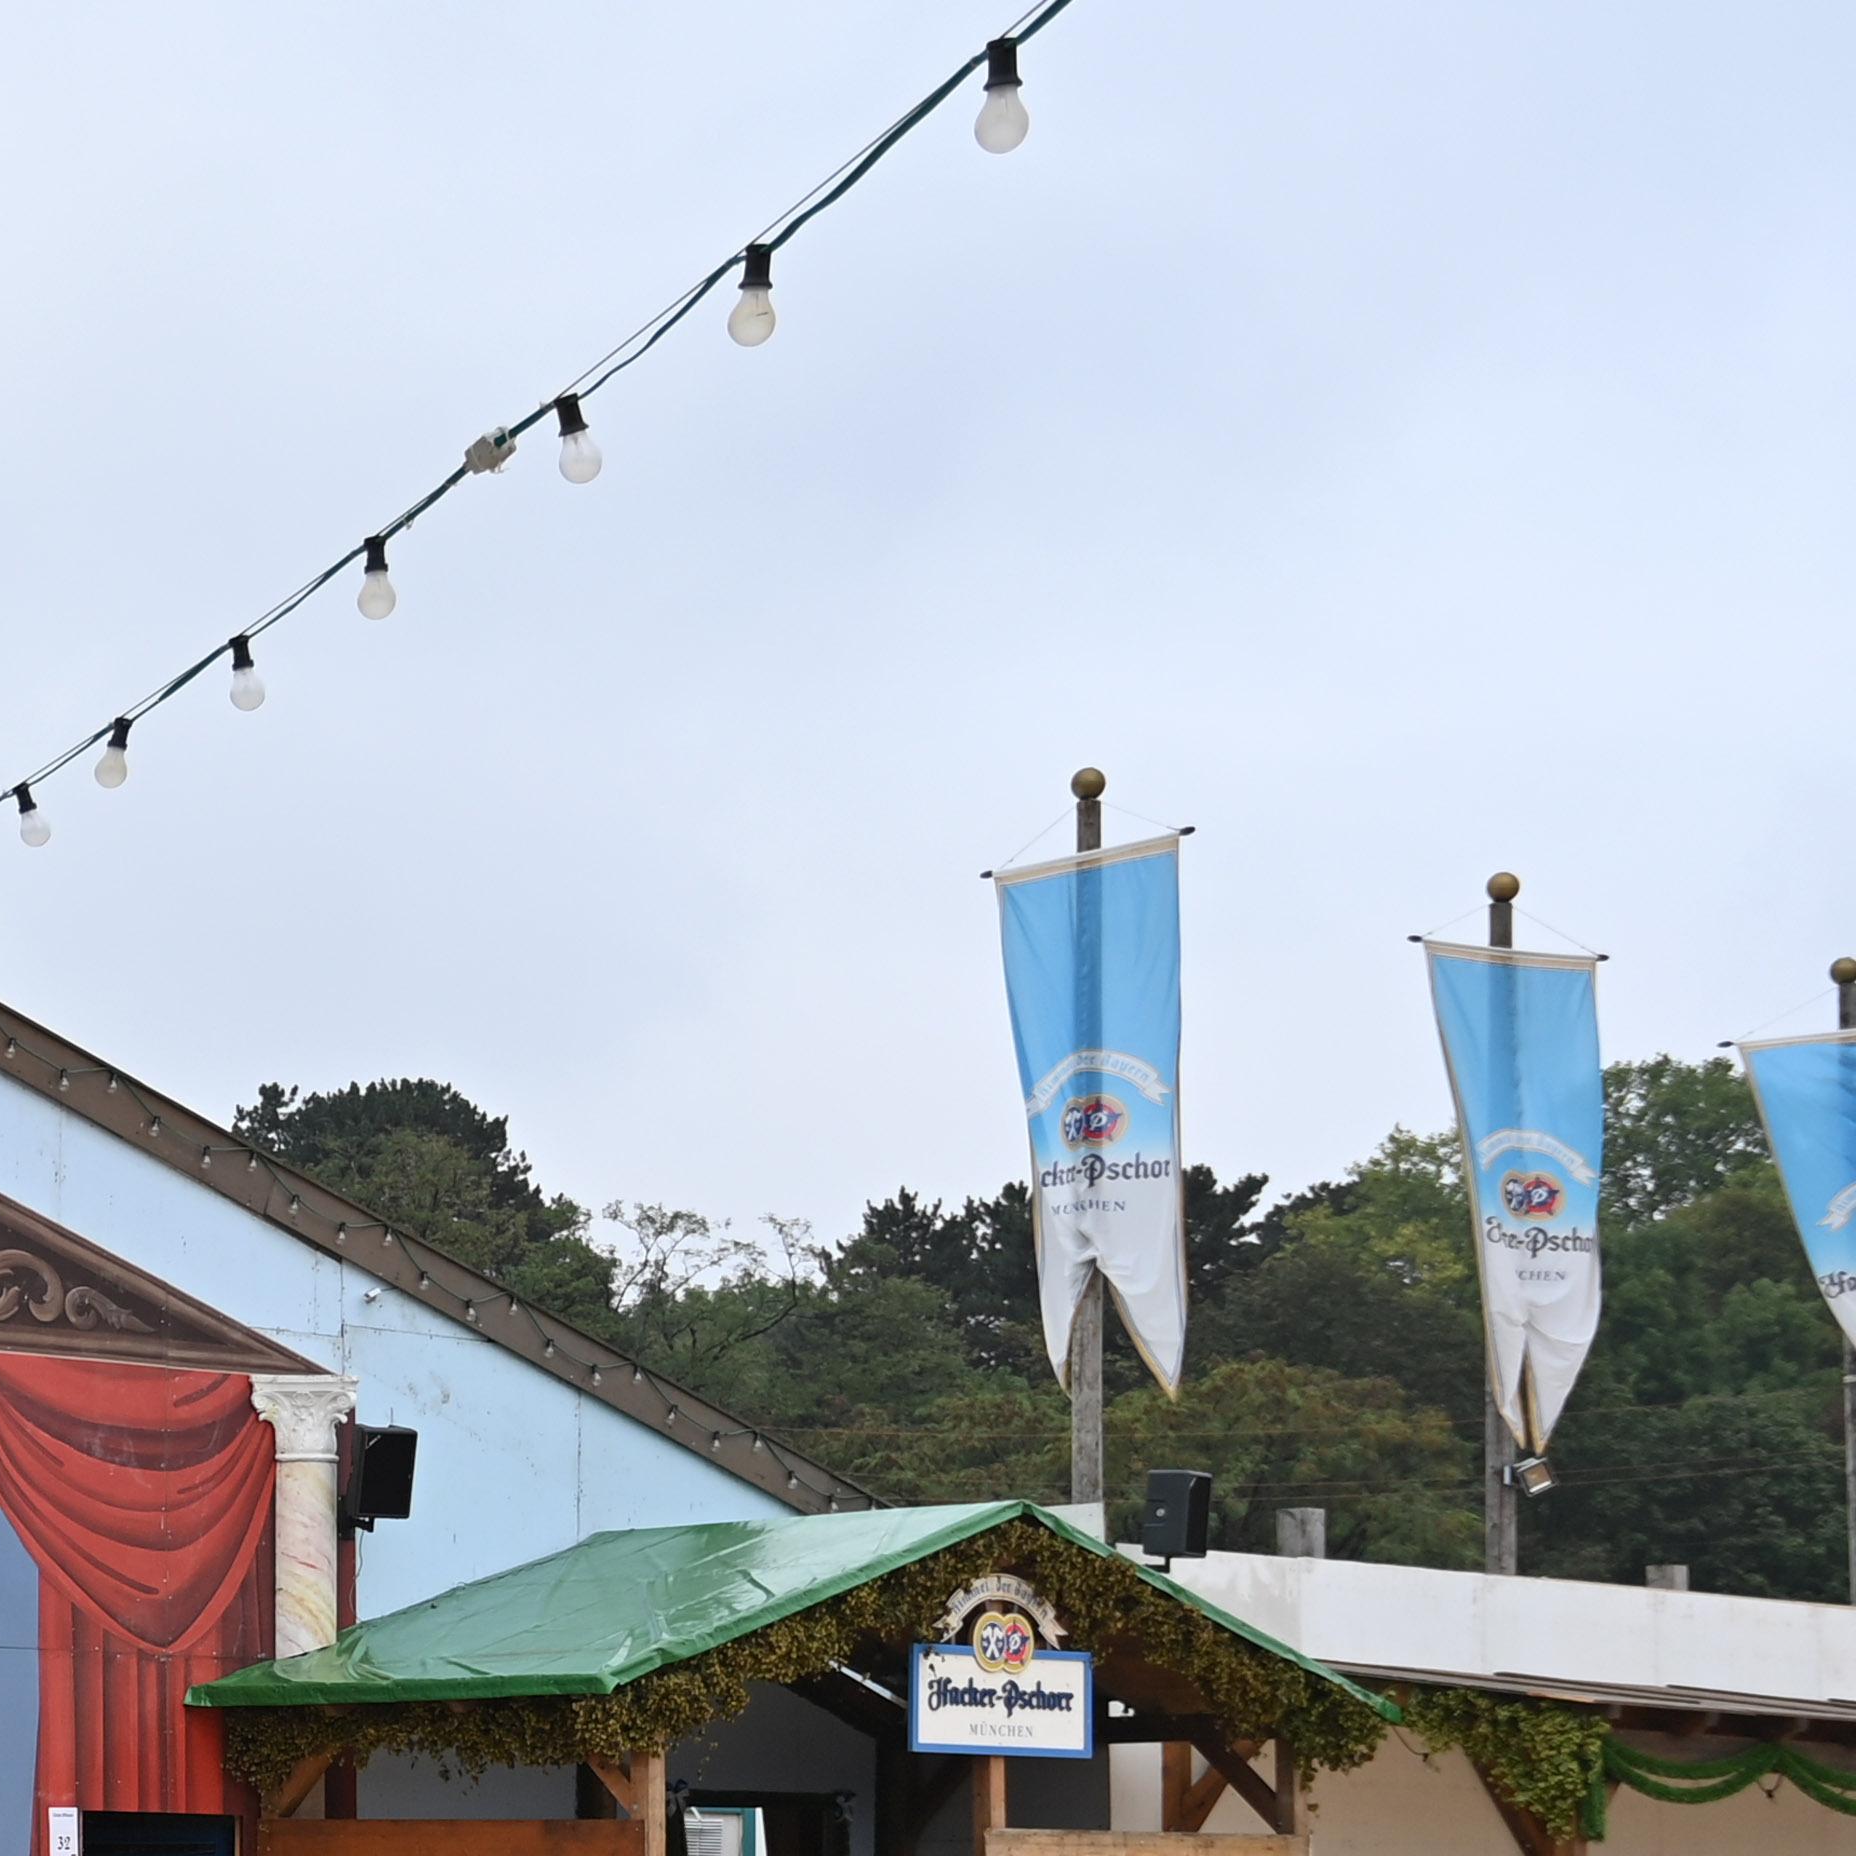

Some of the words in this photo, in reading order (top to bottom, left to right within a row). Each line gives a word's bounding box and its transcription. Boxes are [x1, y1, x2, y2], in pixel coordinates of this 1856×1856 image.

[927, 1675, 1075, 1719] Hacker-Pschorr
[968, 1720, 1035, 1738] MÜNCHEN
[57, 1835, 71, 1851] 32
